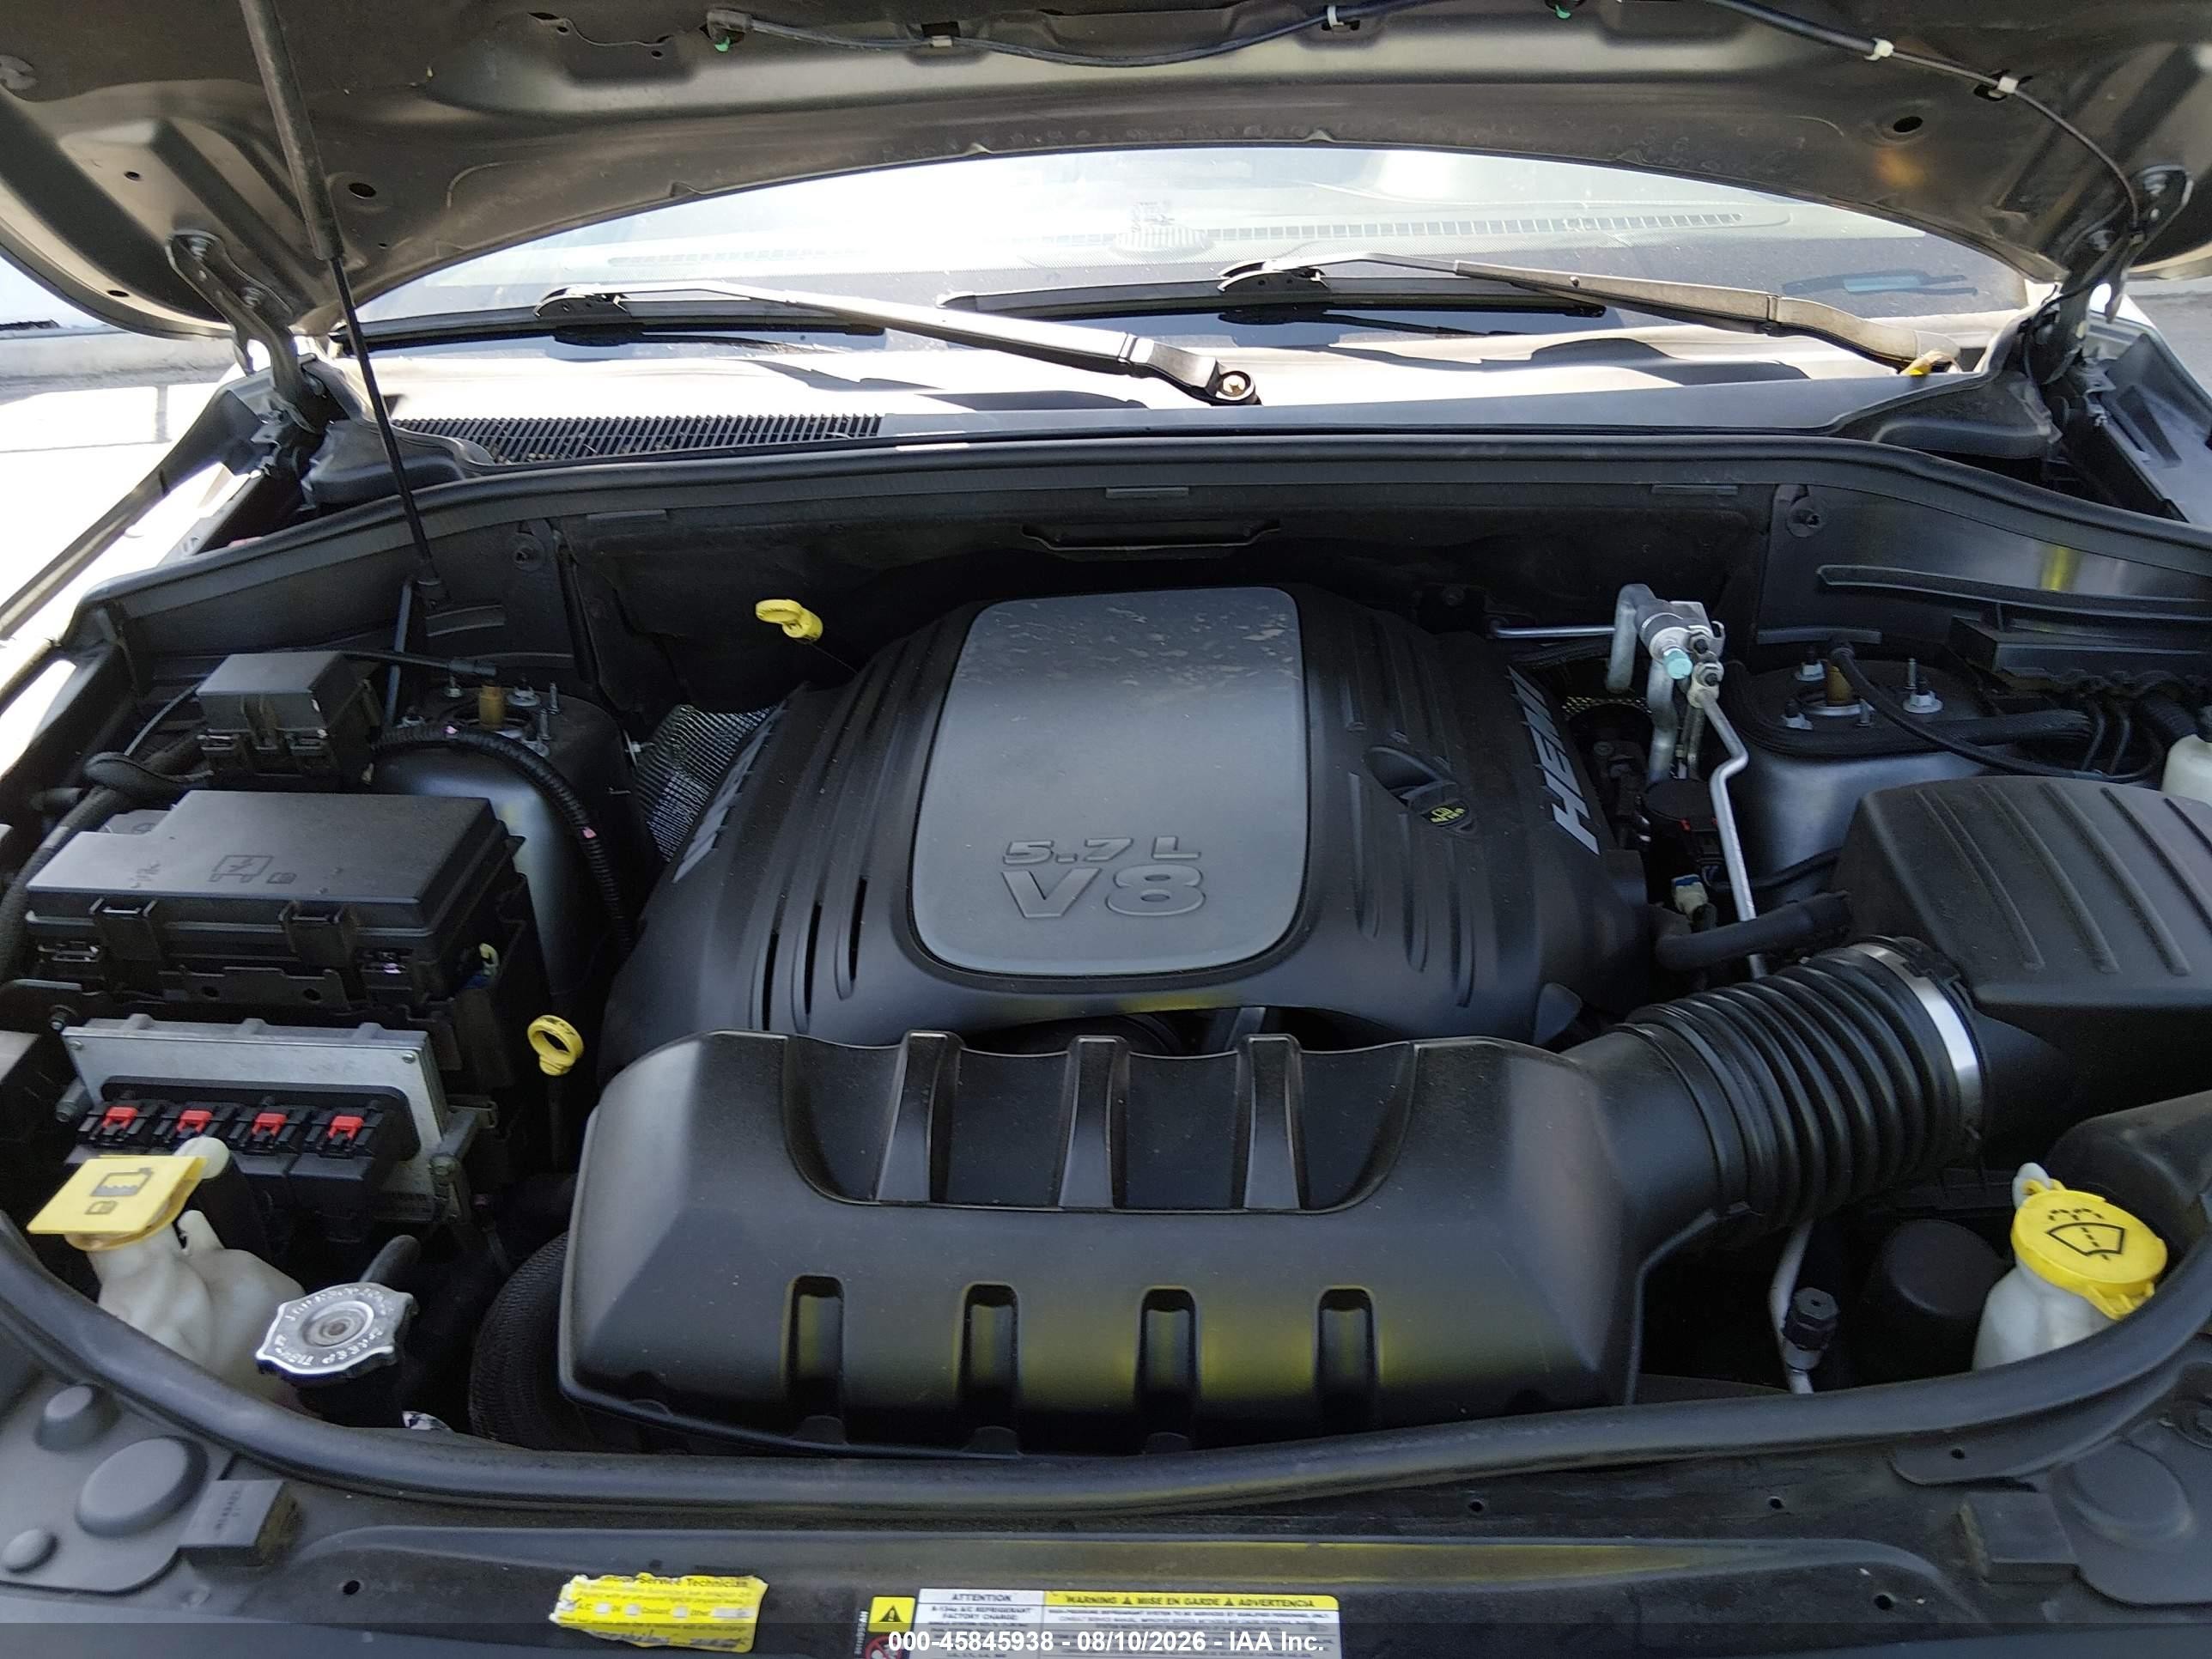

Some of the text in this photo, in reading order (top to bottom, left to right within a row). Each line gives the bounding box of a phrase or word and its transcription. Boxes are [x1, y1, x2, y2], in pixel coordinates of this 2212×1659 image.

[1506, 665, 1601, 856] HEMI
[1001, 863, 1206, 919] V8
[687, 1577, 749, 1588] Technician
[951, 1593, 1012, 1602] ATTENTION
[1066, 1595, 1117, 1604] WARNING
[1168, 1597, 1180, 1606] EN
[1185, 1597, 1219, 1607] GARDE
[1238, 1599, 1316, 1607] ADVERTENCIA
